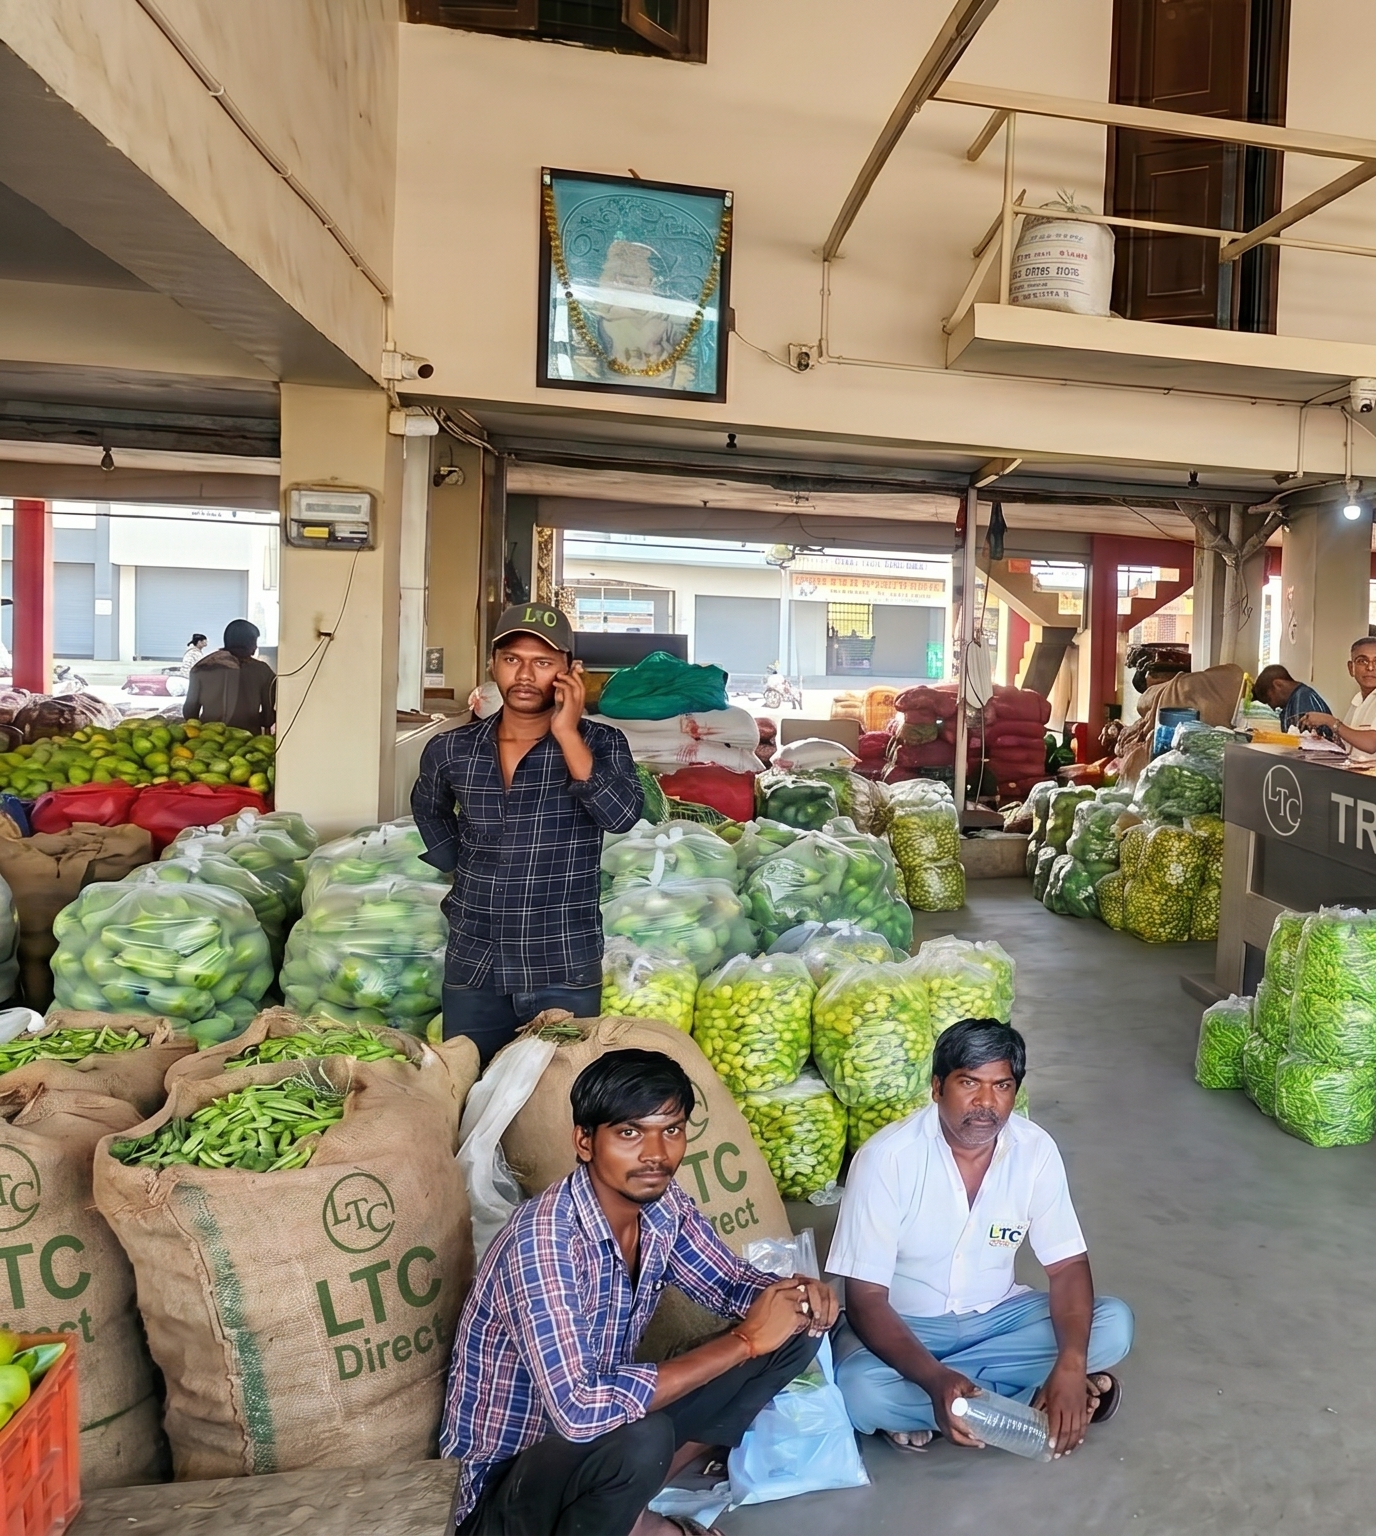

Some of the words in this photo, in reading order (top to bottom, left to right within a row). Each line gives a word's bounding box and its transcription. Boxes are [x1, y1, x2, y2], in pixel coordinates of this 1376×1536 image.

[1268, 770, 1301, 827] LTC
[0, 1174, 34, 1214] TC
[681, 1142, 748, 1204] TC
[329, 1191, 391, 1233] LTC
[711, 1197, 760, 1237] rect
[0, 1234, 92, 1310] TC
[315, 1245, 443, 1338] LTC
[333, 1311, 448, 1381] Direct
